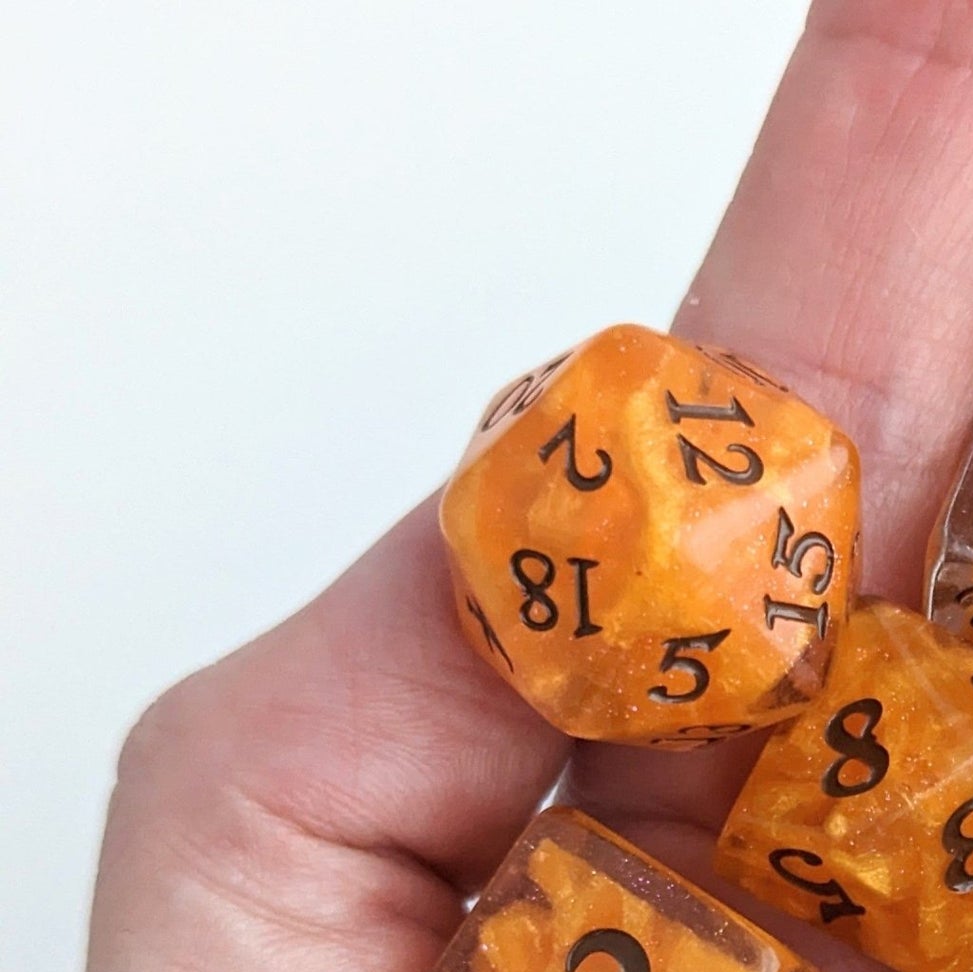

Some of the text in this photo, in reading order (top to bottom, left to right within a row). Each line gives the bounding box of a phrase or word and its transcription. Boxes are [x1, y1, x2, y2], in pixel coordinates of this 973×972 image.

[538, 413, 613, 493] 2
[665, 388, 765, 488] 12
[509, 547, 603, 640] 18
[763, 506, 836, 641] 15
[648, 628, 732, 705] 5
[821, 697, 891, 798] 8
[768, 847, 867, 925] 5
